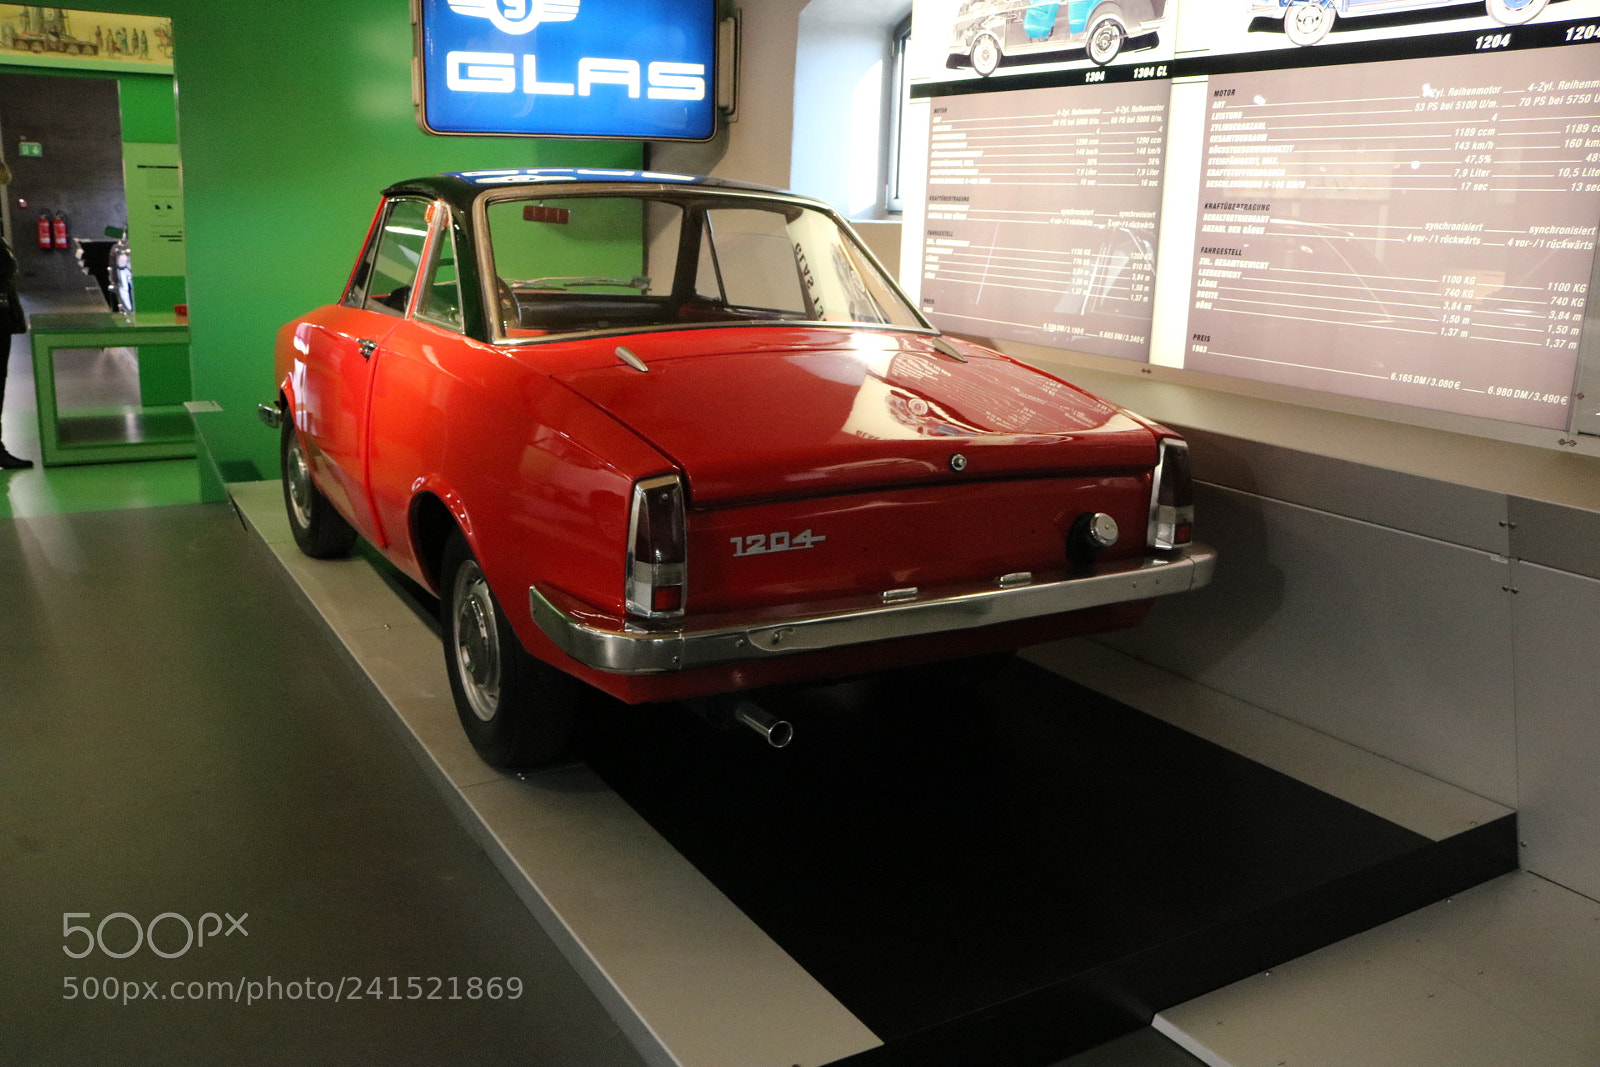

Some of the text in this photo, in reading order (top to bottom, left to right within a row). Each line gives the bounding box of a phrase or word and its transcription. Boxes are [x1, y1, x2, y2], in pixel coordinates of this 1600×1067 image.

[1475, 33, 1512, 50] 1204
[446, 50, 706, 101] GLAS
[1085, 71, 1106, 82] 1304
[1133, 66, 1155, 79] 1304
[1448, 86, 1502, 97] Reihenmotor
[1527, 82, 1554, 93] 4-Zyl.
[1213, 89, 1236, 97] MOTOR
[1520, 98, 1531, 106] 70
[1533, 96, 1546, 105] PS
[1548, 96, 1563, 105] bei
[1566, 94, 1591, 104] 5750
[1414, 104, 1425, 112] 53
[1427, 103, 1438, 111] PS
[1440, 102, 1452, 111] bei
[1456, 101, 1477, 110] 5100
[1491, 113, 1499, 122] 4
[1454, 128, 1496, 137] 1189 ccm
[1565, 124, 1589, 133] 1189
[1454, 141, 1494, 150] 143 km/h
[1564, 139, 1581, 148] 160
[1464, 155, 1492, 164] 47,5%
[1454, 169, 1491, 179] 7,9 Liter
[1558, 168, 1579, 178] 10,5
[1460, 182, 1471, 191] 17
[1571, 182, 1583, 192] 13
[1425, 222, 1484, 232] synchronisiert
[1528, 226, 1597, 236] synchronisiert
[1406, 234, 1412, 242] 4
[1440, 235, 1481, 245] rückwärts
[1507, 239, 1514, 247] 4
[1546, 239, 1594, 250] rückwärts
[1200, 246, 1242, 256] FAHRGESTELL
[1442, 275, 1476, 285] 1100 KG
[1444, 288, 1474, 298] 740 KG
[1547, 282, 1587, 294] 1100 KG
[1443, 302, 1472, 312] 3,84 m
[1550, 297, 1584, 308] 740 KG
[1442, 314, 1470, 325] 1,50 m
[1549, 311, 1581, 322] 3,84 m
[1440, 328, 1468, 338] 1,37 m
[1547, 325, 1579, 336] 1,50 m
[1192, 333, 1211, 342] PREIS
[1545, 339, 1577, 350] 1,37 m
[730, 529, 826, 557] 1204
